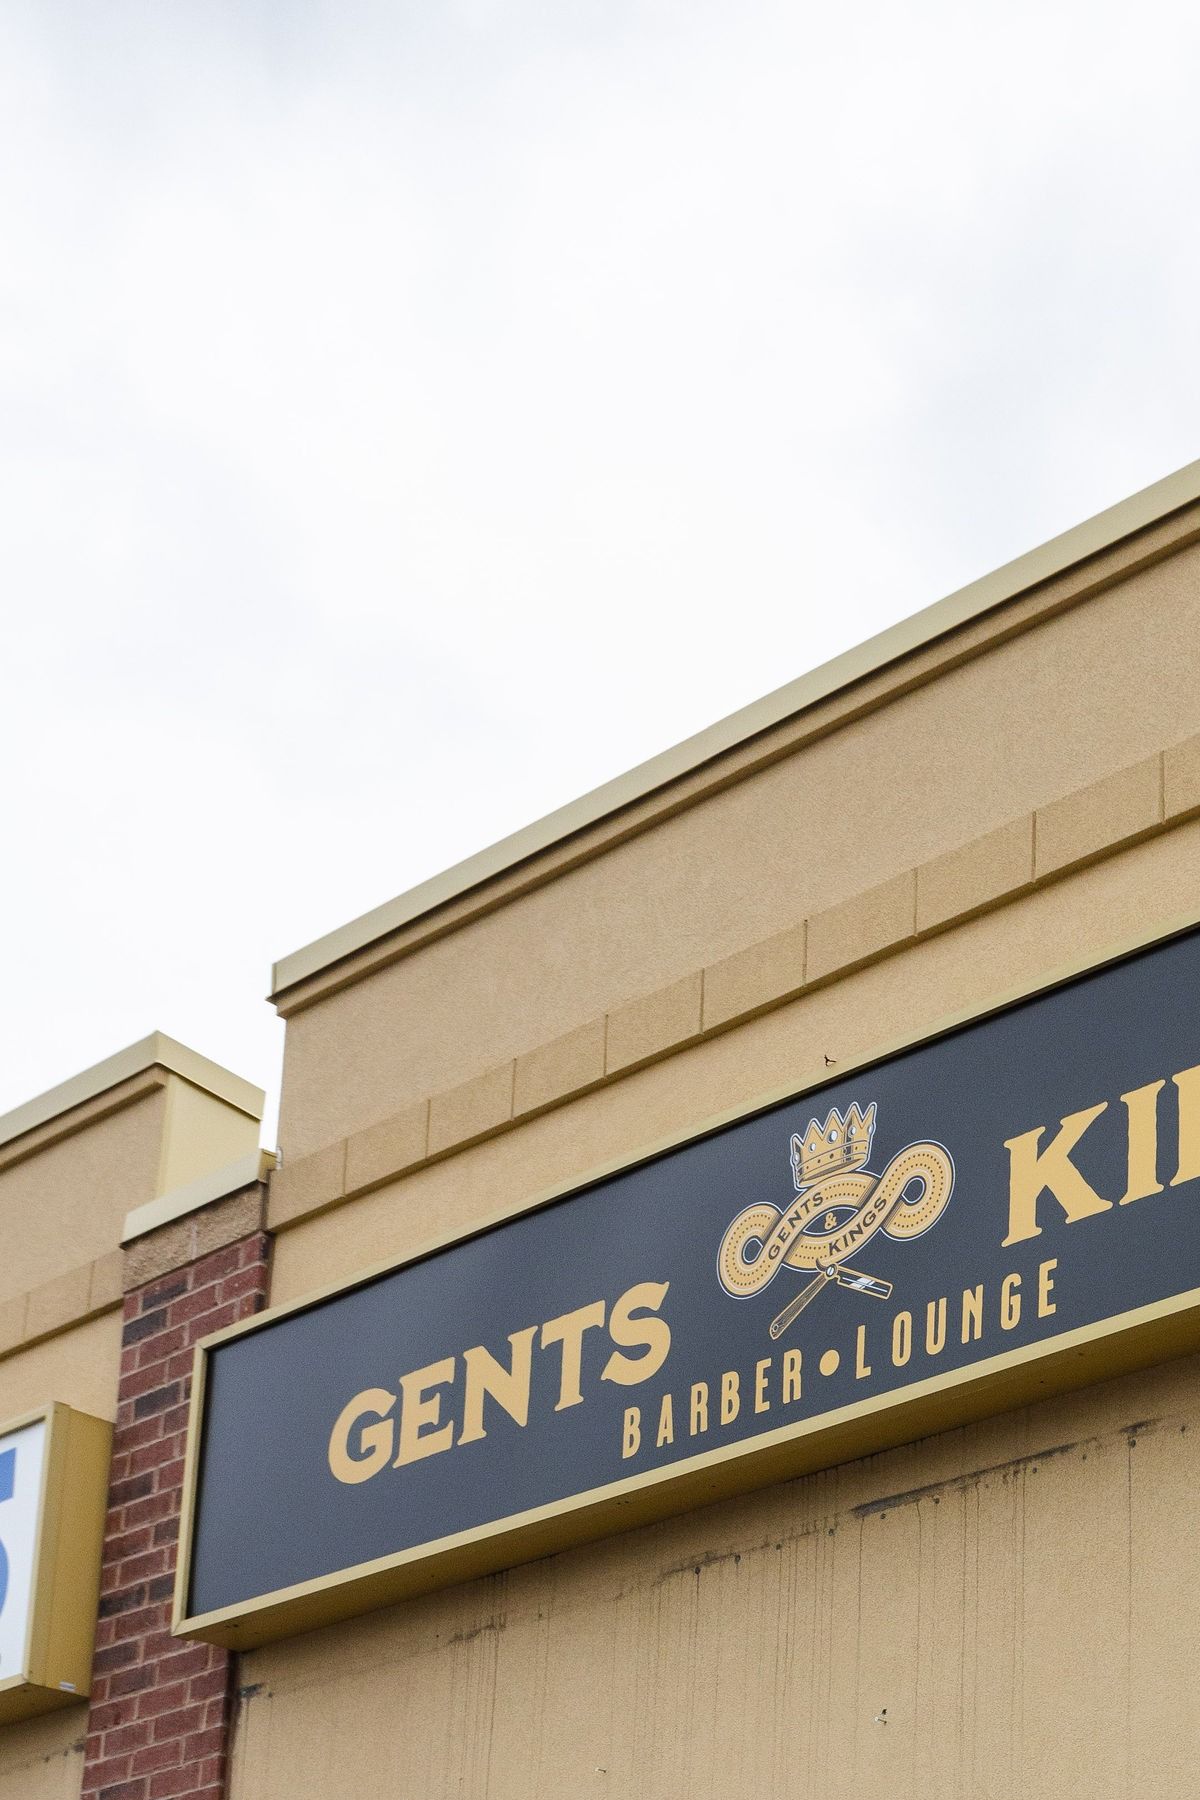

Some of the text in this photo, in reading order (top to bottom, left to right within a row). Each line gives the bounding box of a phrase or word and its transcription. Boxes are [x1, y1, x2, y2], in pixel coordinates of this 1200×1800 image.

[768, 1192, 887, 1261] GENTS & KINGS
[328, 1281, 672, 1485] GENTS
[622, 1258, 1058, 1459] BARBER LOUNGE
